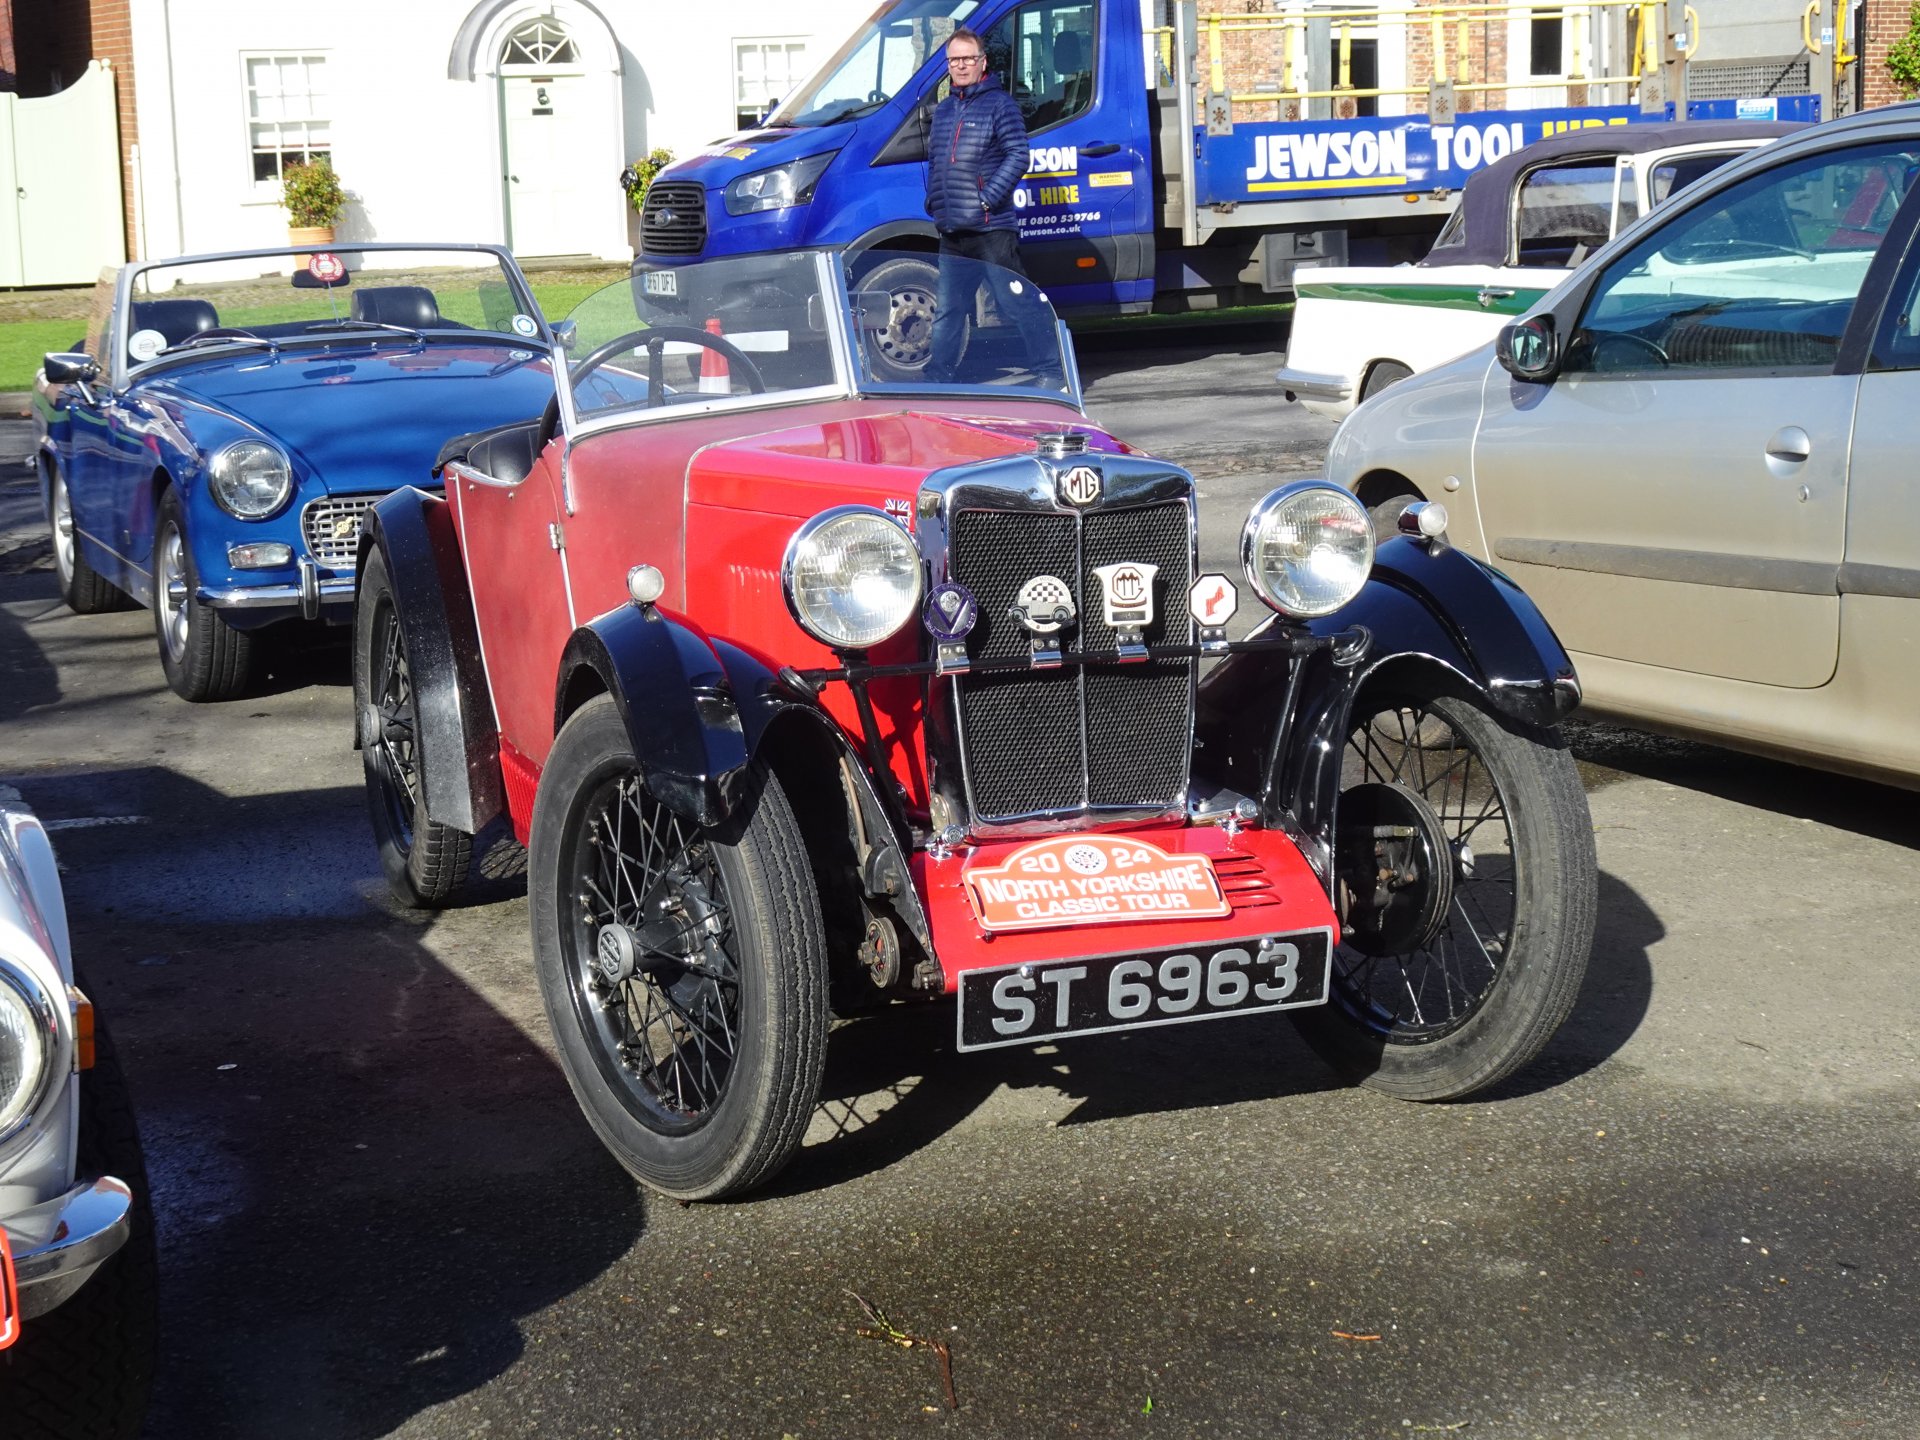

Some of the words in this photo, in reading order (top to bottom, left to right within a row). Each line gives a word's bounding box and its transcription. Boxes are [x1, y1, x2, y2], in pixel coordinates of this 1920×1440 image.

[1246, 129, 1406, 180] JEWSON
[1040, 185, 1079, 206] HIRE
[1030, 215, 1057, 225] 0800
[1061, 211, 1100, 223] 539766
[661, 273, 675, 292] DFZ
[1070, 470, 1096, 499] MG
[1020, 852, 1061, 873] 20
[1111, 848, 1151, 868] 24
[979, 877, 1067, 903] NORTH
[1071, 864, 1207, 895] YORKSHIRE
[1016, 896, 1120, 918] CLASSIC
[1124, 893, 1190, 909] TOUR
[992, 966, 1087, 1035] ST
[1108, 943, 1299, 1020] 6963
